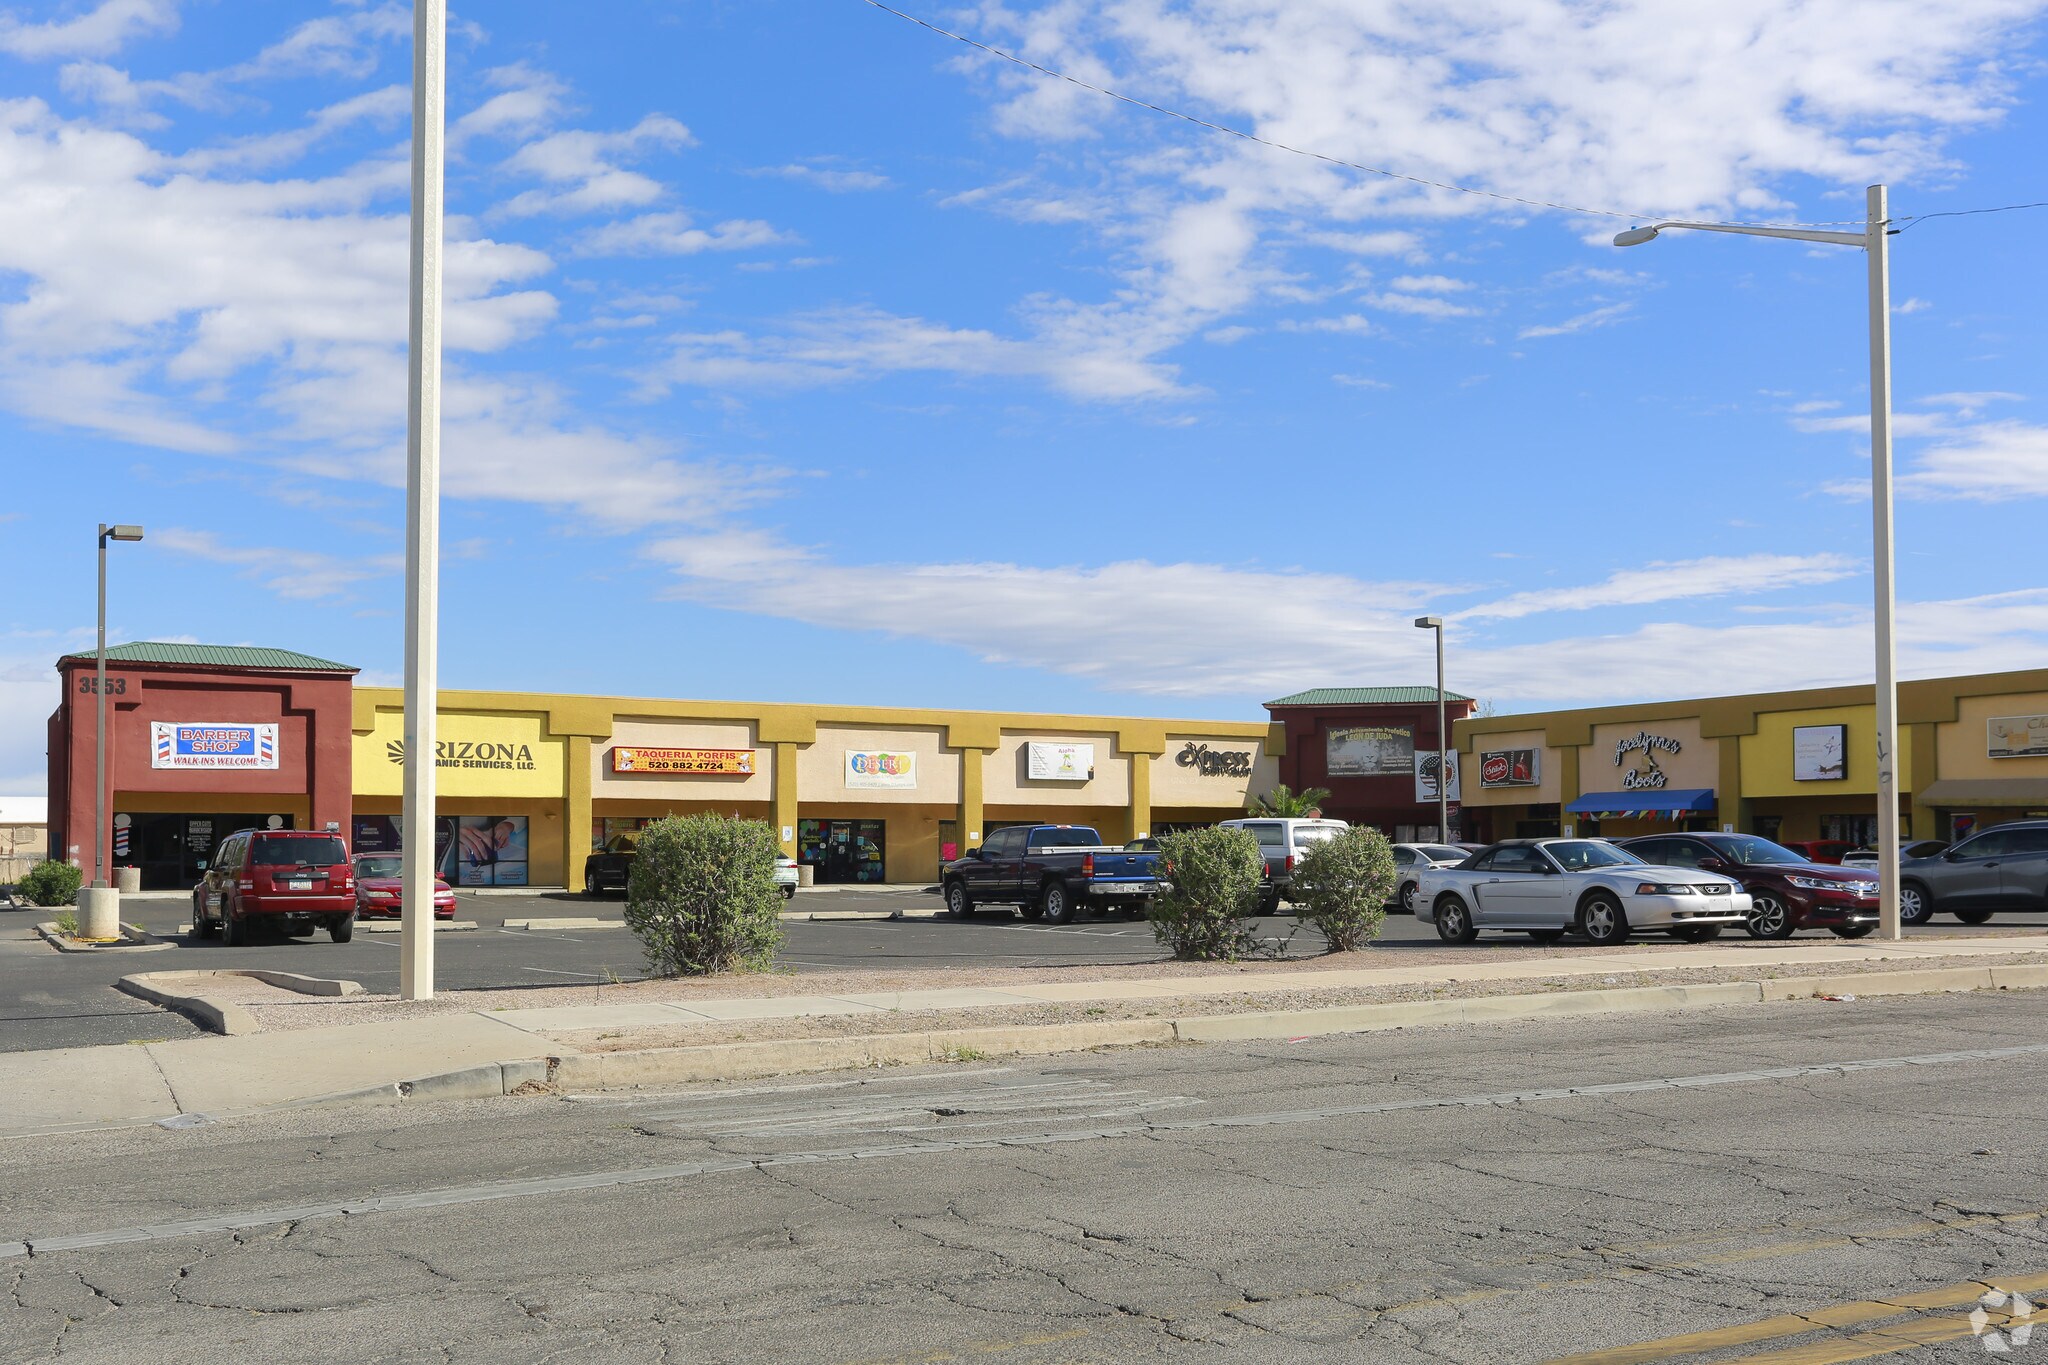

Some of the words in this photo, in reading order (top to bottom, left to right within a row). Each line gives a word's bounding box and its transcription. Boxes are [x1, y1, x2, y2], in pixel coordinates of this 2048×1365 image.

[180, 729, 251, 741] BARBER
[1329, 730, 1349, 740] Iglesia
[191, 741, 240, 753] SHOP
[435, 740, 533, 761] RIZONA
[636, 750, 693, 759] TAQUERIA
[697, 751, 736, 760] PORFIS
[217, 757, 259, 766] WELCOME
[462, 759, 515, 771] SERVICES,
[517, 761, 537, 770] LLC.
[1623, 769, 1666, 790] Boots
